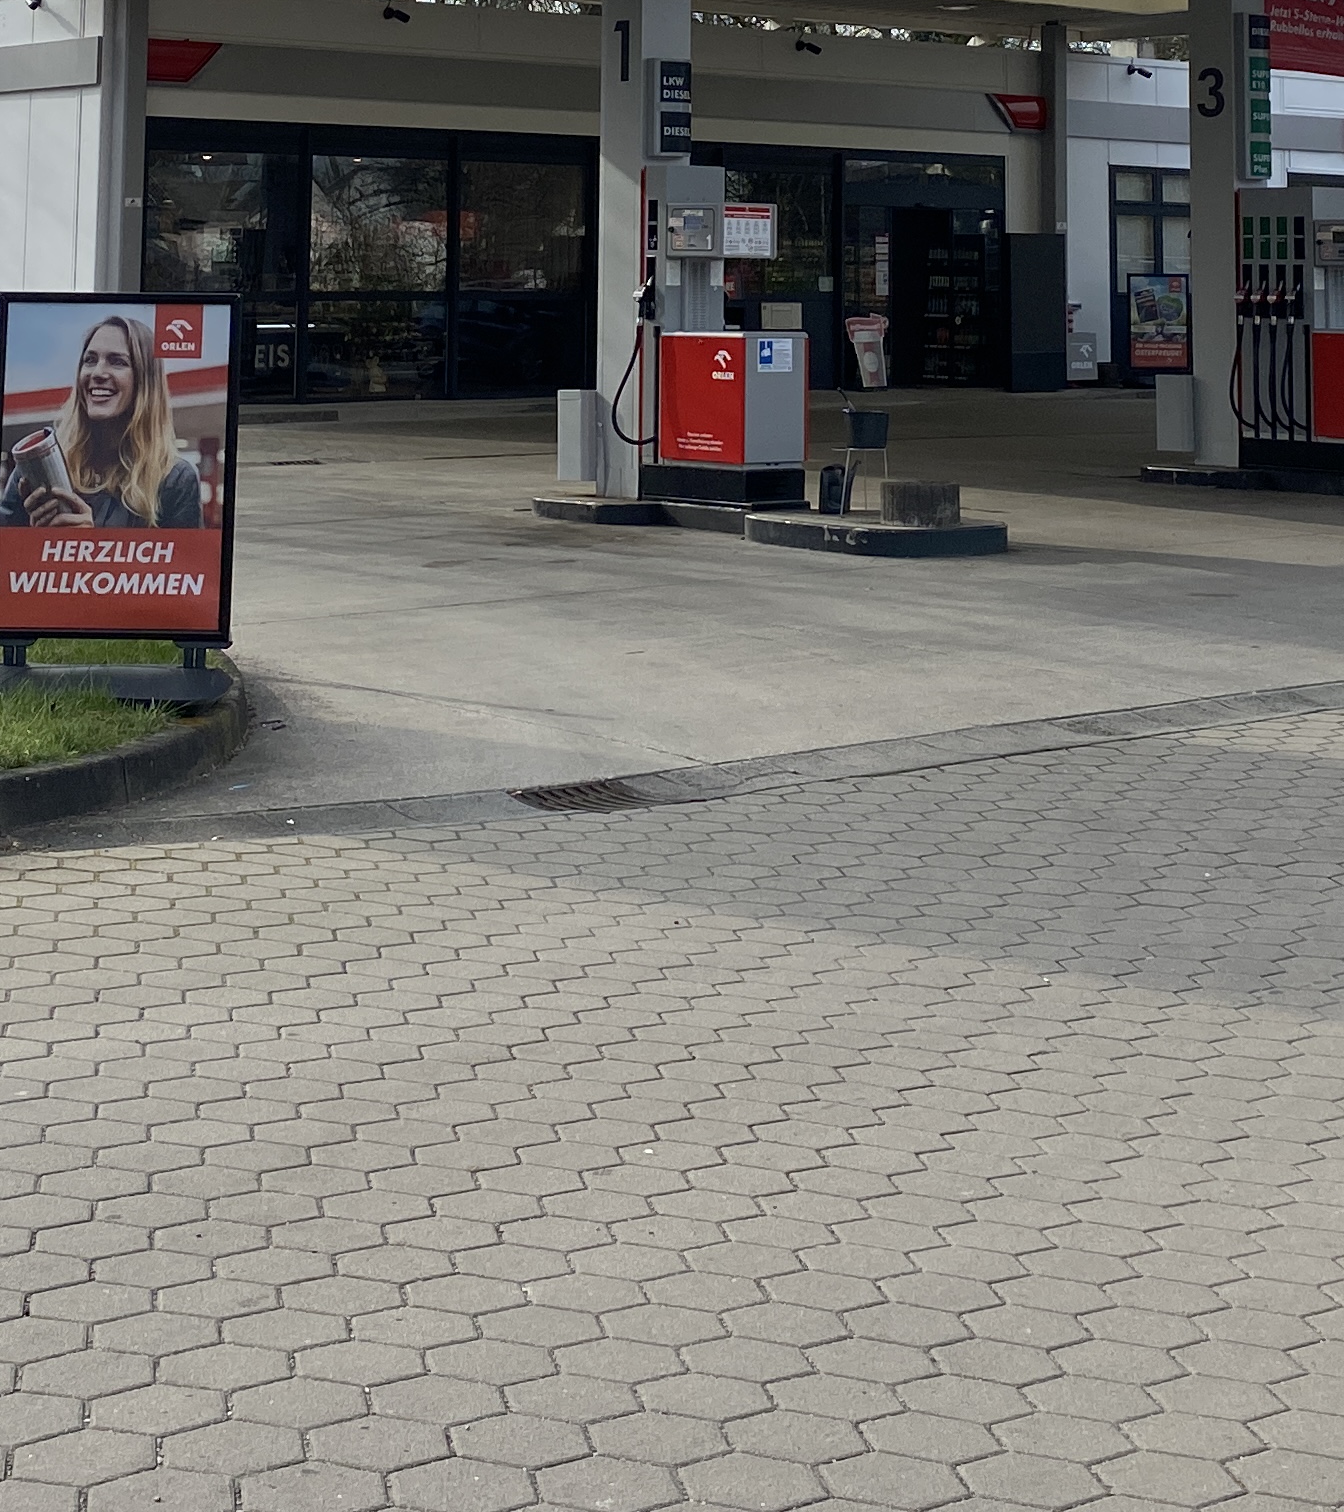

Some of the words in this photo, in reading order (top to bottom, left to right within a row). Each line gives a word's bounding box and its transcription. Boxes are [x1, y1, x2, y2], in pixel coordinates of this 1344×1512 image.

[613, 19, 630, 82] 1
[663, 75, 684, 86] LKW
[1197, 68, 1225, 117] 3
[161, 342, 195, 351] ORLEN
[254, 344, 290, 368] EIS
[41, 540, 174, 564] HERZLICH
[9, 571, 205, 596] WILLKOMMEN
